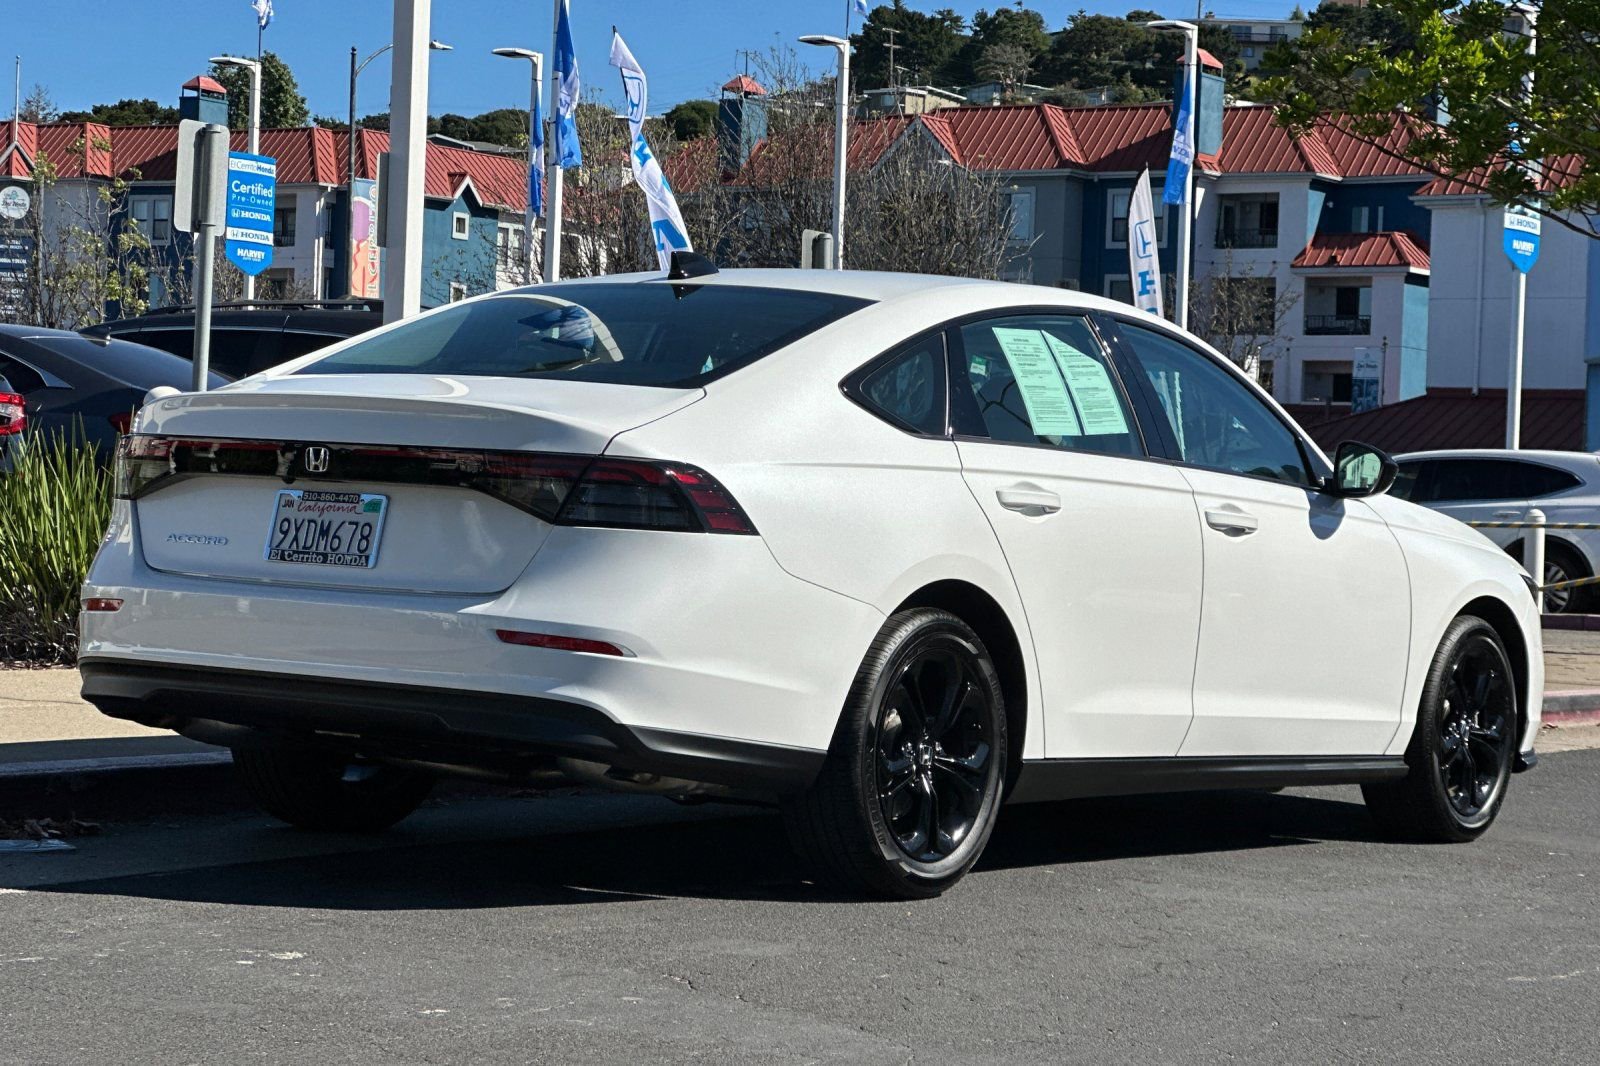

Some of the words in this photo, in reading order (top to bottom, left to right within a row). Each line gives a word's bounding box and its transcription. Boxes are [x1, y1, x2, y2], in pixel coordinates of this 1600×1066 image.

[231, 180, 273, 198] Certified
[231, 193, 273, 207] Pre-Owned
[240, 210, 272, 222] HONDA
[240, 231, 270, 242] HONDA
[237, 248, 266, 260] HARVEY
[282, 499, 295, 509] JAN
[303, 492, 359, 503] 510-860-4470
[297, 499, 363, 518] California
[166, 533, 229, 546] ACCORD
[275, 517, 373, 554] 9XDM678
[270, 551, 281, 561] El
[284, 551, 323, 564] Cerrito
[326, 554, 367, 567] HONDA
